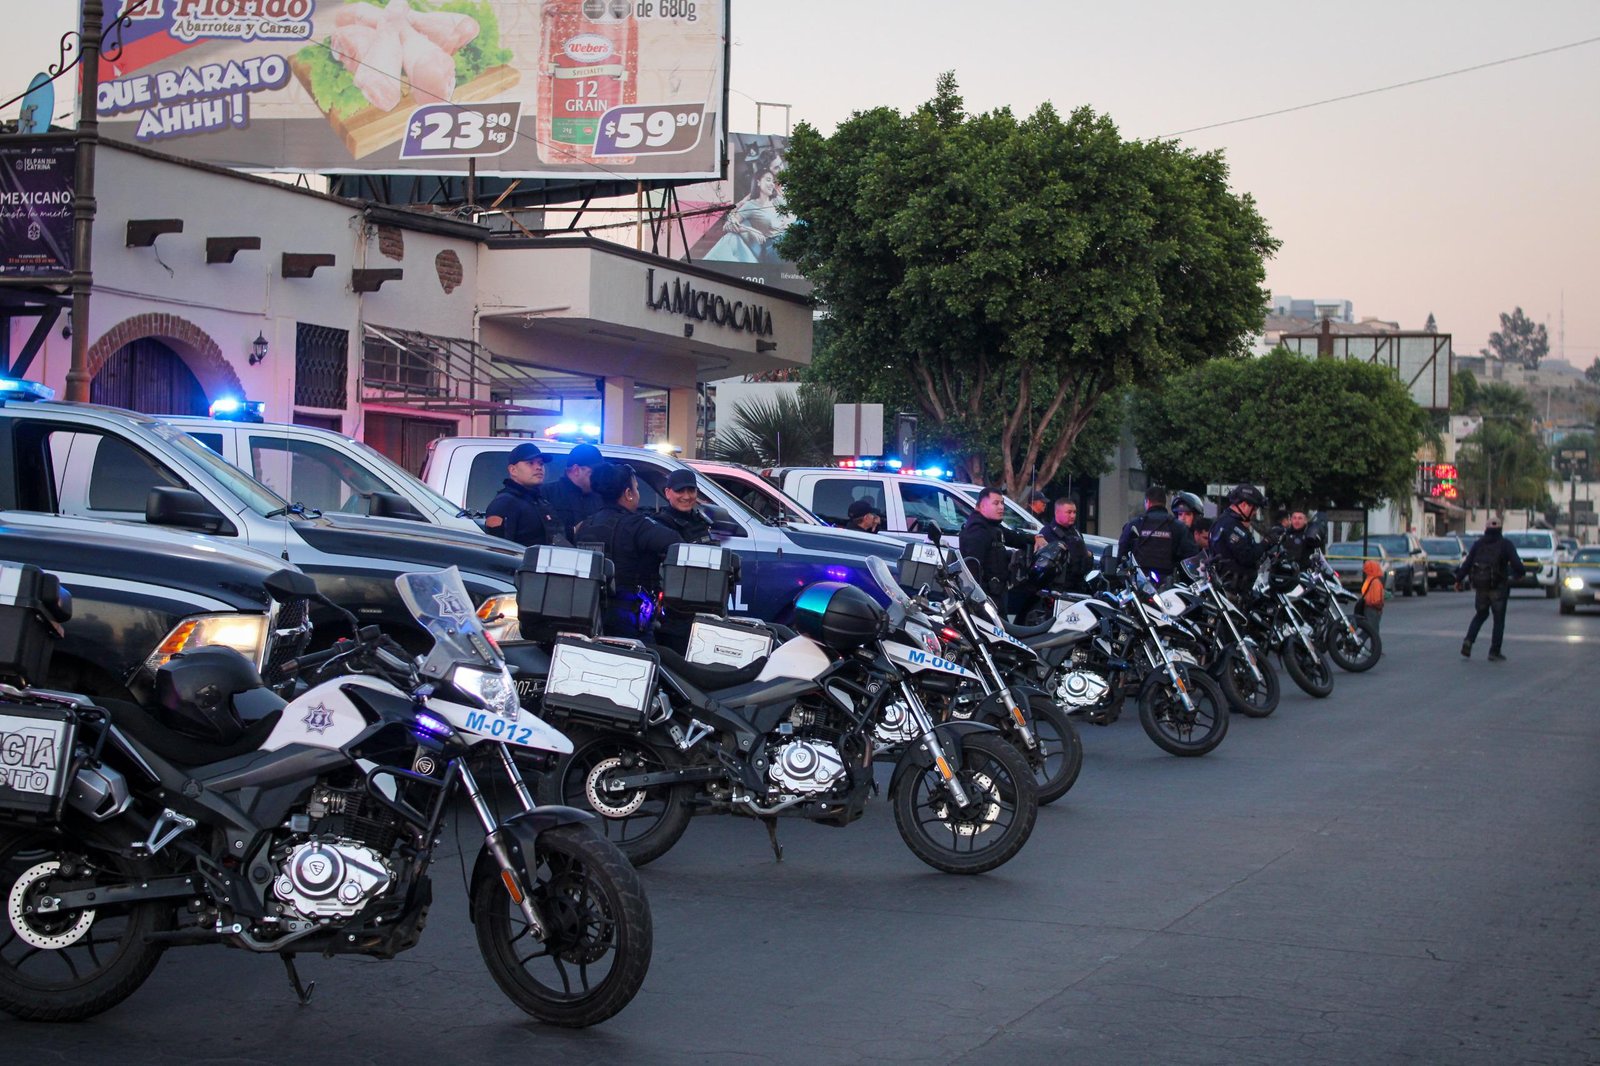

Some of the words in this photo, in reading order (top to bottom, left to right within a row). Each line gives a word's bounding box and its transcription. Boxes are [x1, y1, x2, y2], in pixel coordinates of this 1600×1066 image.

[176, 0, 308, 18] Florido
[637, 0, 653, 17] de
[659, 0, 697, 21] 680g
[175, 20, 241, 37] Abarrotes
[245, 24, 255, 34] y
[259, 22, 306, 34] Carnes
[97, 76, 151, 110] QUE
[156, 56, 285, 99] BARATO
[576, 80, 599, 98] 12
[565, 99, 608, 112] GRAIN
[488, 130, 507, 143] kg
[0, 191, 71, 205] MEXICANO
[465, 710, 533, 745] M-012
[0, 732, 56, 771] CIA
